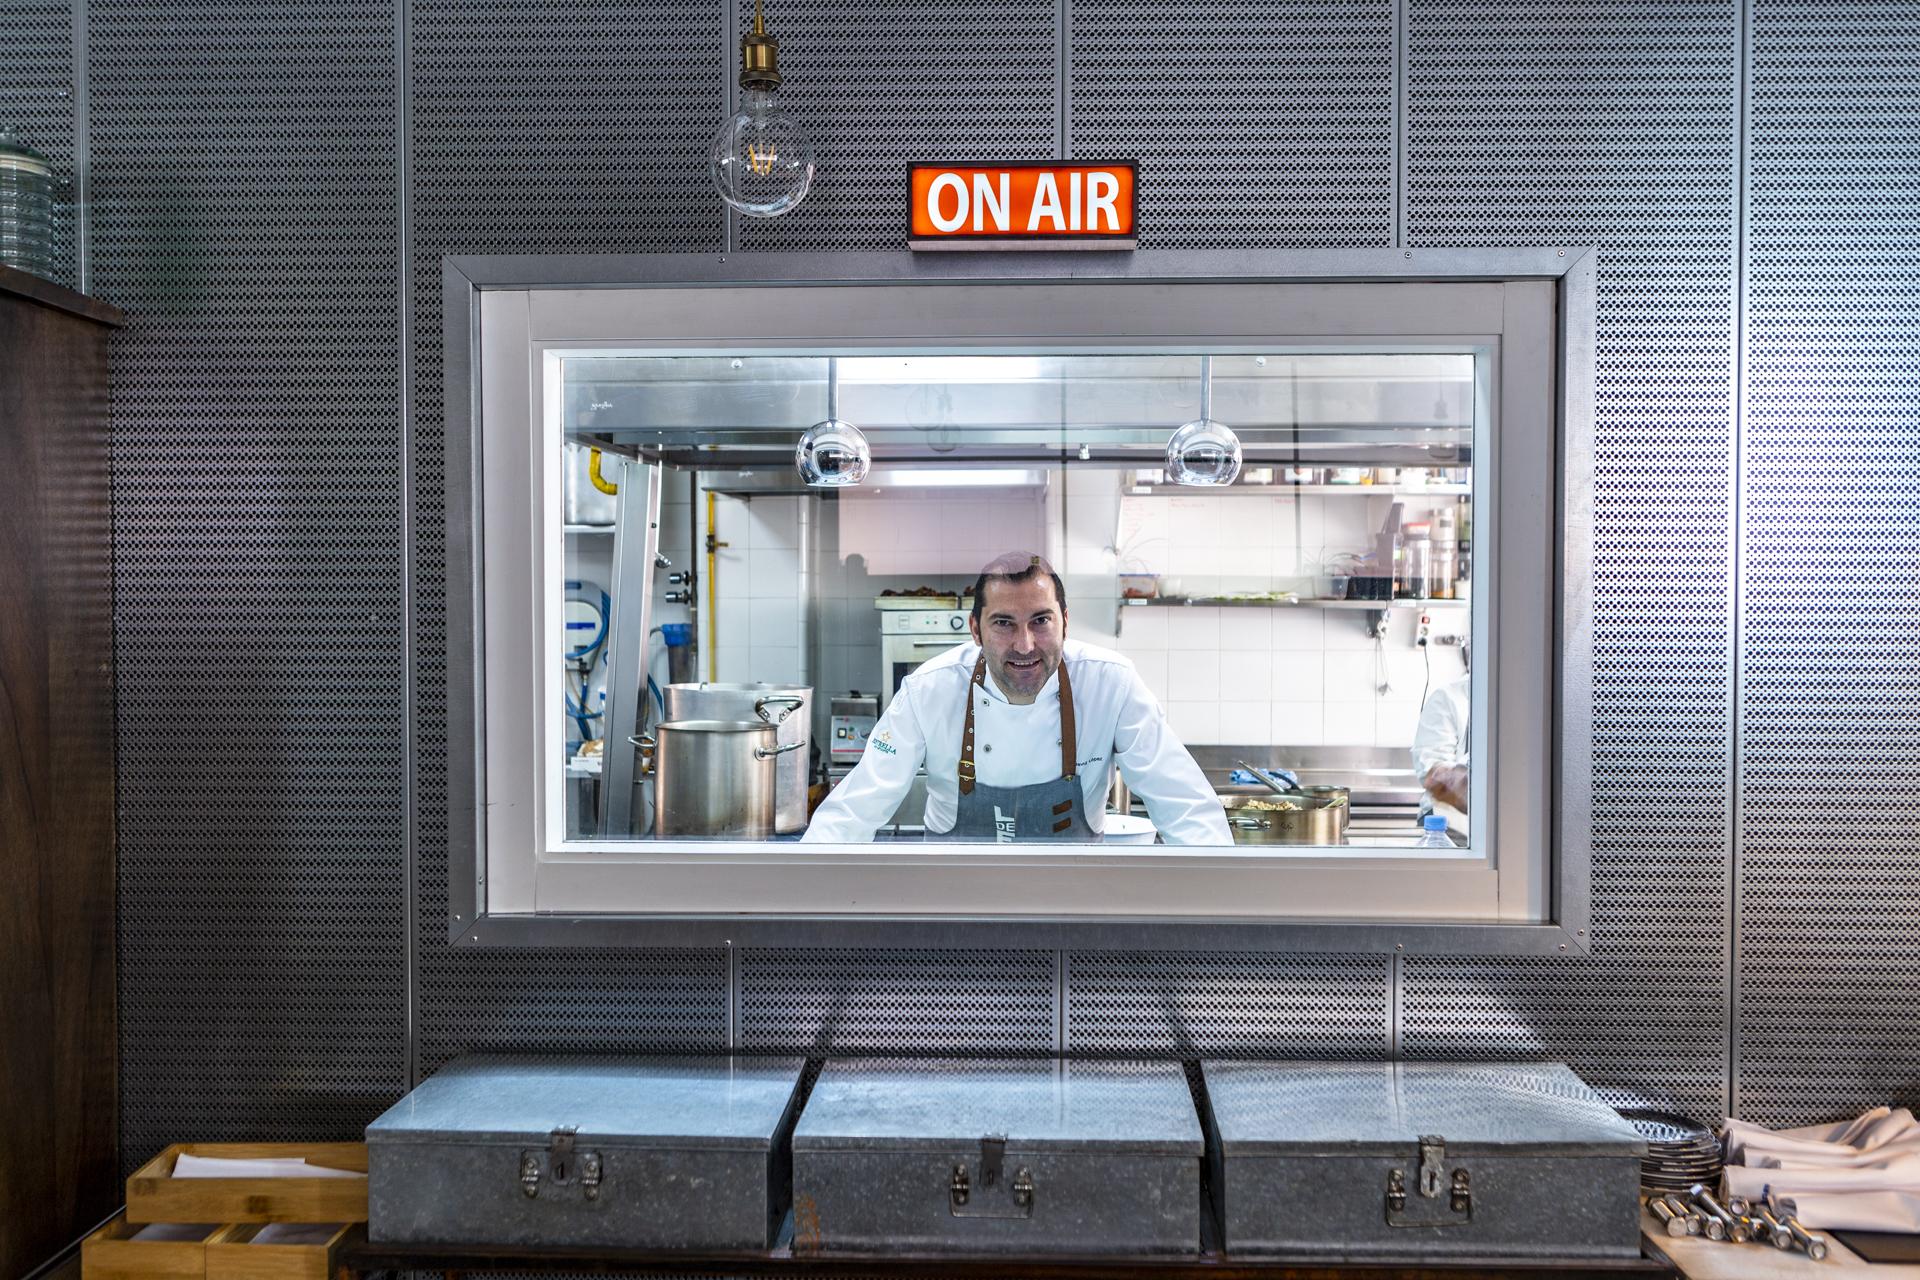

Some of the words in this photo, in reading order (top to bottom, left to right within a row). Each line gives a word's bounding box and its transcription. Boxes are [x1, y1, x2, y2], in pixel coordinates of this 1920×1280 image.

[927, 172, 1010, 232] ON
[1027, 172, 1121, 231] AIR
[996, 822, 1015, 832] DE
